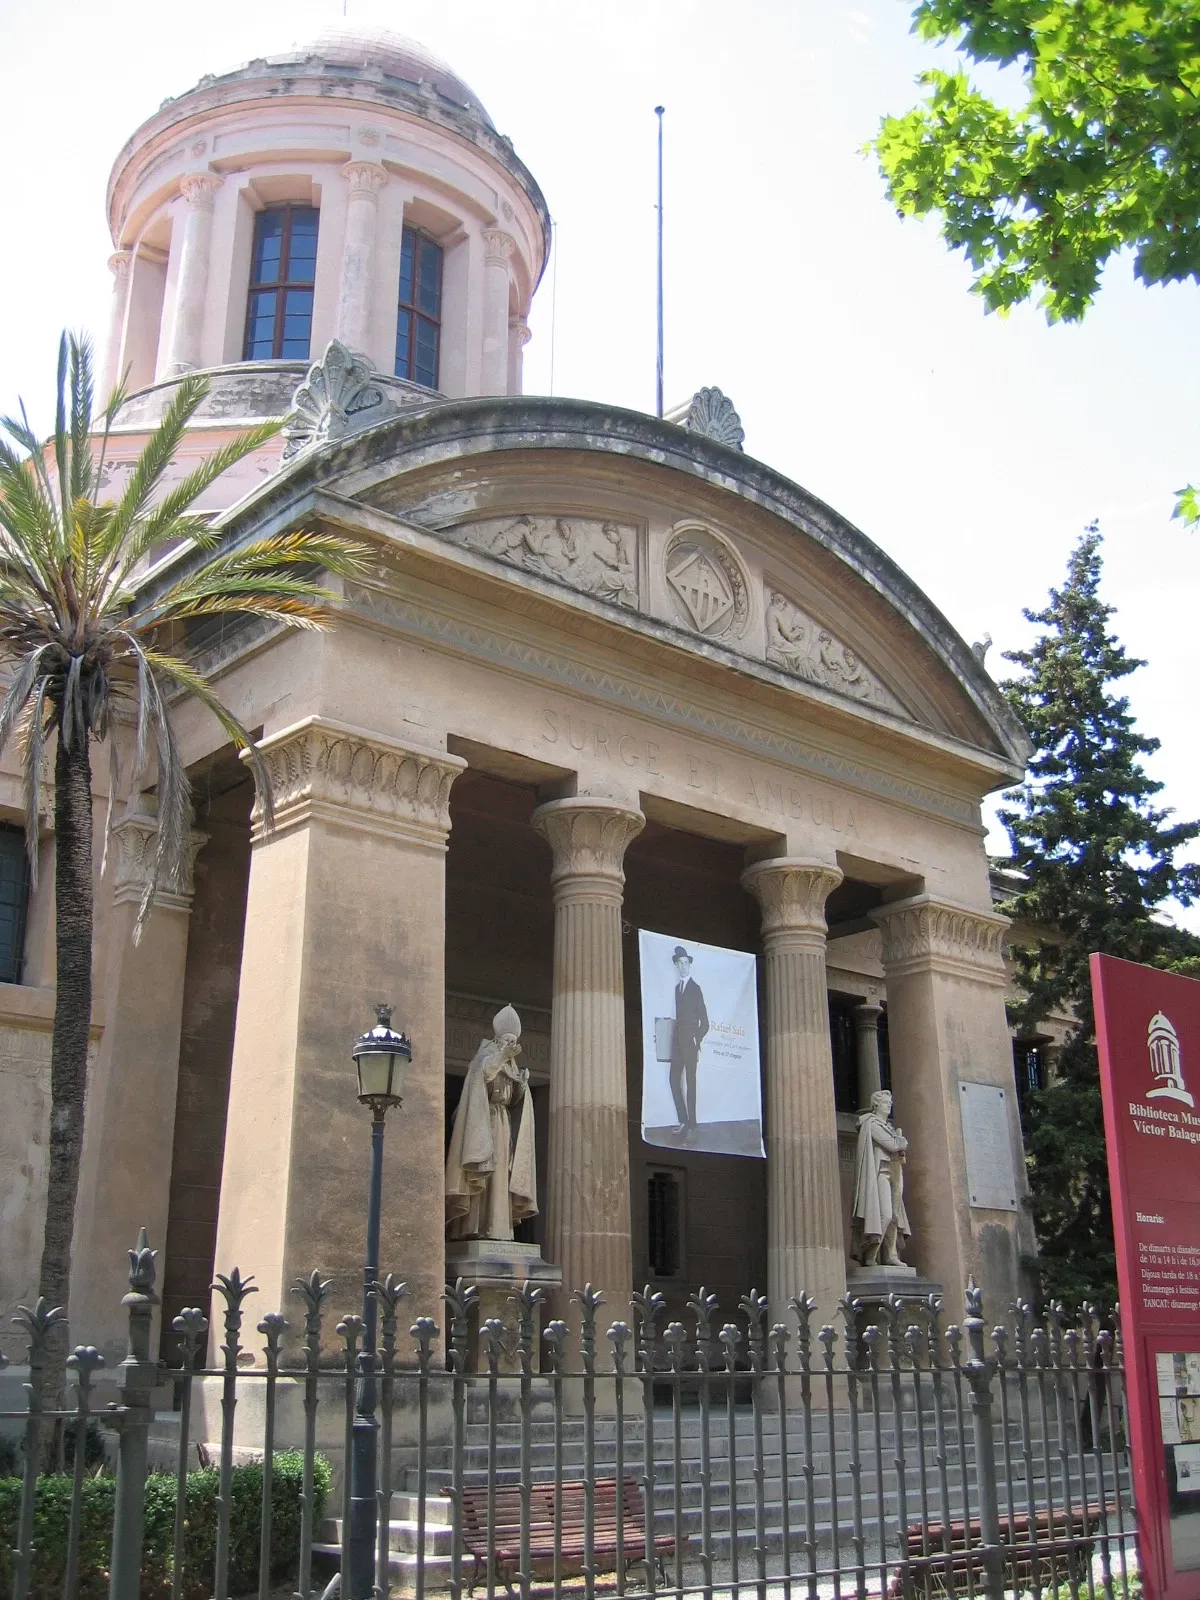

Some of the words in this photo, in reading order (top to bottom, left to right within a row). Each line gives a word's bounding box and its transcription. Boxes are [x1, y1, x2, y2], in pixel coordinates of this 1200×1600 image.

[687, 754, 723, 795] ET
[744, 776, 861, 840] AMBULA
[711, 1020, 731, 1033] Rafael
[1129, 1103, 1179, 1122] Biblioteca
[1136, 1212, 1164, 1223] Horaris:
[1139, 1242, 1148, 1252] De
[1140, 1254, 1147, 1264] de
[1149, 1254, 1157, 1264] 10
[1163, 1255, 1170, 1265] 14
[1181, 1256, 1188, 1266] de
[1141, 1268, 1160, 1280] Dijous
[1161, 1270, 1177, 1279] tarda
[1178, 1271, 1185, 1280] de
[1142, 1284, 1174, 1295] Diumenges
[1143, 1298, 1170, 1308] TANCAT:
[1171, 1299, 1198, 1311] diumenge
